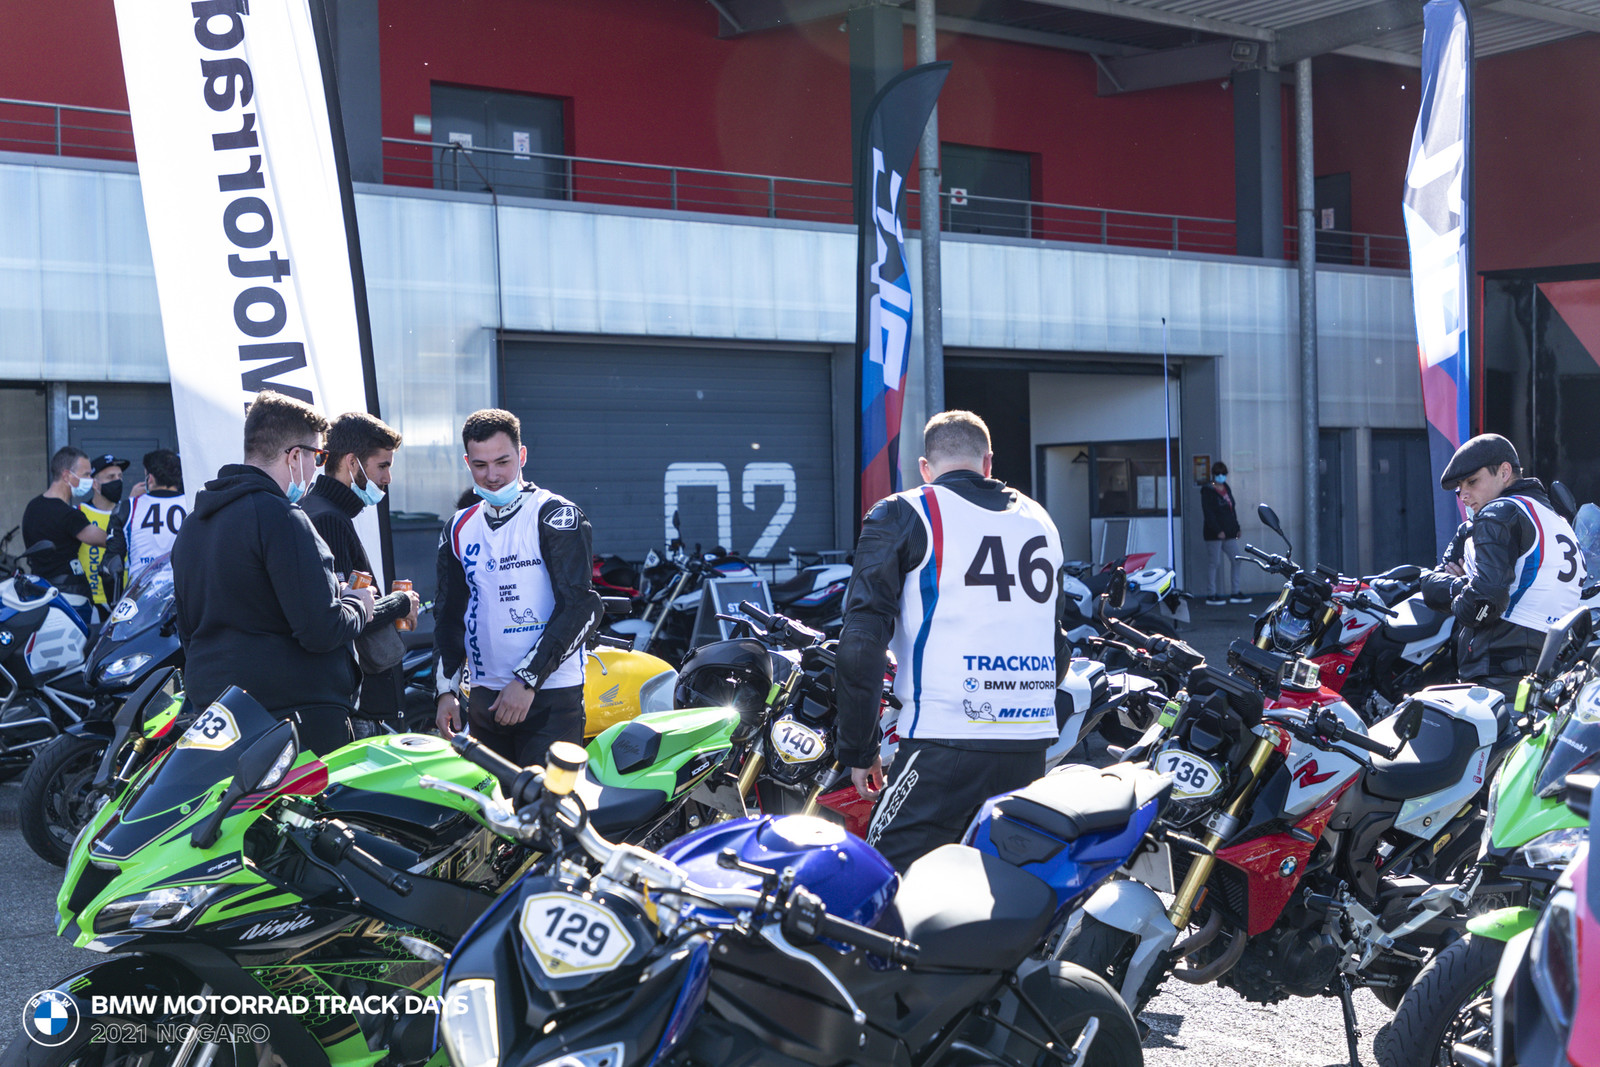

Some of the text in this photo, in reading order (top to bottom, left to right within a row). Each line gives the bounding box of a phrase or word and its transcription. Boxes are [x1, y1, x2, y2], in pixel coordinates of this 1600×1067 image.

[68, 395, 99, 420] 03
[141, 503, 187, 535] 40
[664, 462, 799, 583] 02
[499, 559, 542, 571] MOTORRAD
[500, 554, 518, 564] BMW
[964, 535, 1055, 604] 46
[963, 656, 1056, 671] TRACKDAY
[984, 681, 1056, 690] BMW MOTORR
[781, 726, 816, 756] 140
[691, 761, 710, 776] 1000
[1167, 756, 1209, 789] 136
[239, 913, 316, 941] Ninja
[545, 905, 611, 957] 129
